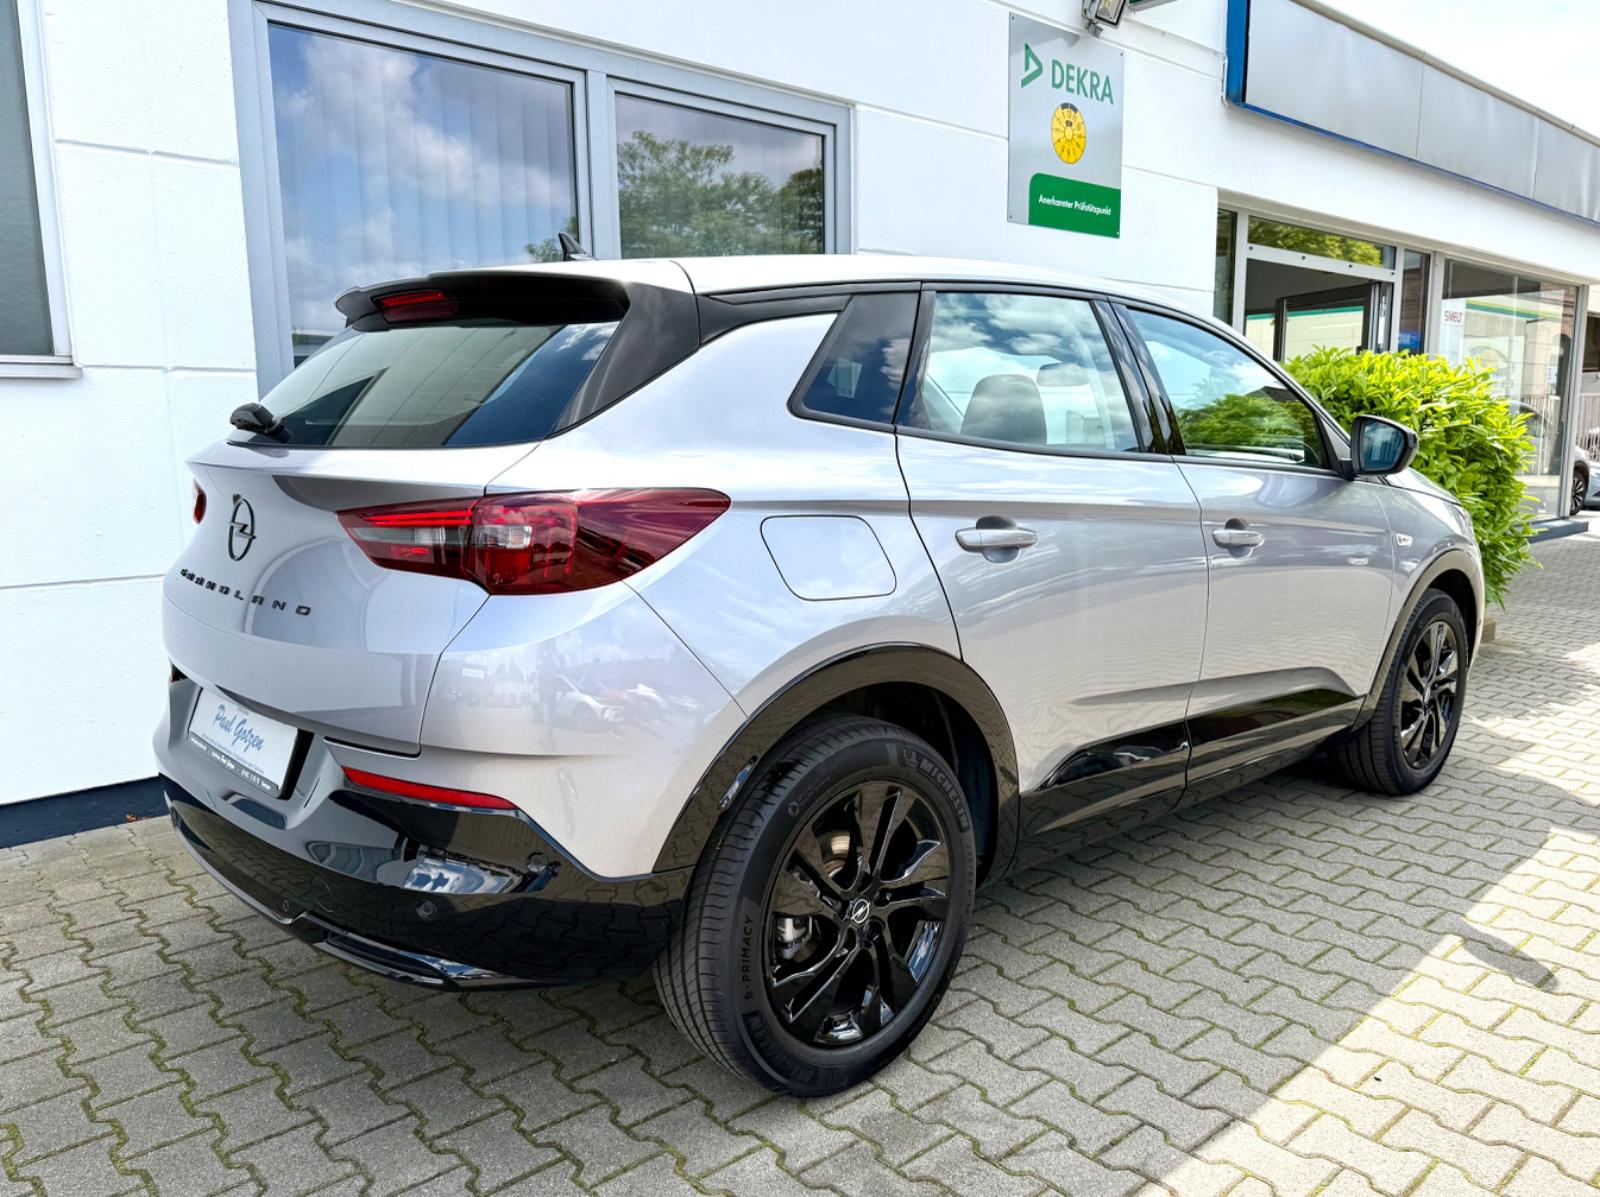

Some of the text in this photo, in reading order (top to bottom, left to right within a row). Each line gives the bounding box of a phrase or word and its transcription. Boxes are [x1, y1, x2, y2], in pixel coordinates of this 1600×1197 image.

[1051, 58, 1114, 105] DEKRA
[1038, 194, 1074, 209] Anerkannter
[212, 703, 265, 753] Paul Gotzen
[919, 758, 969, 829] MICHELIN
